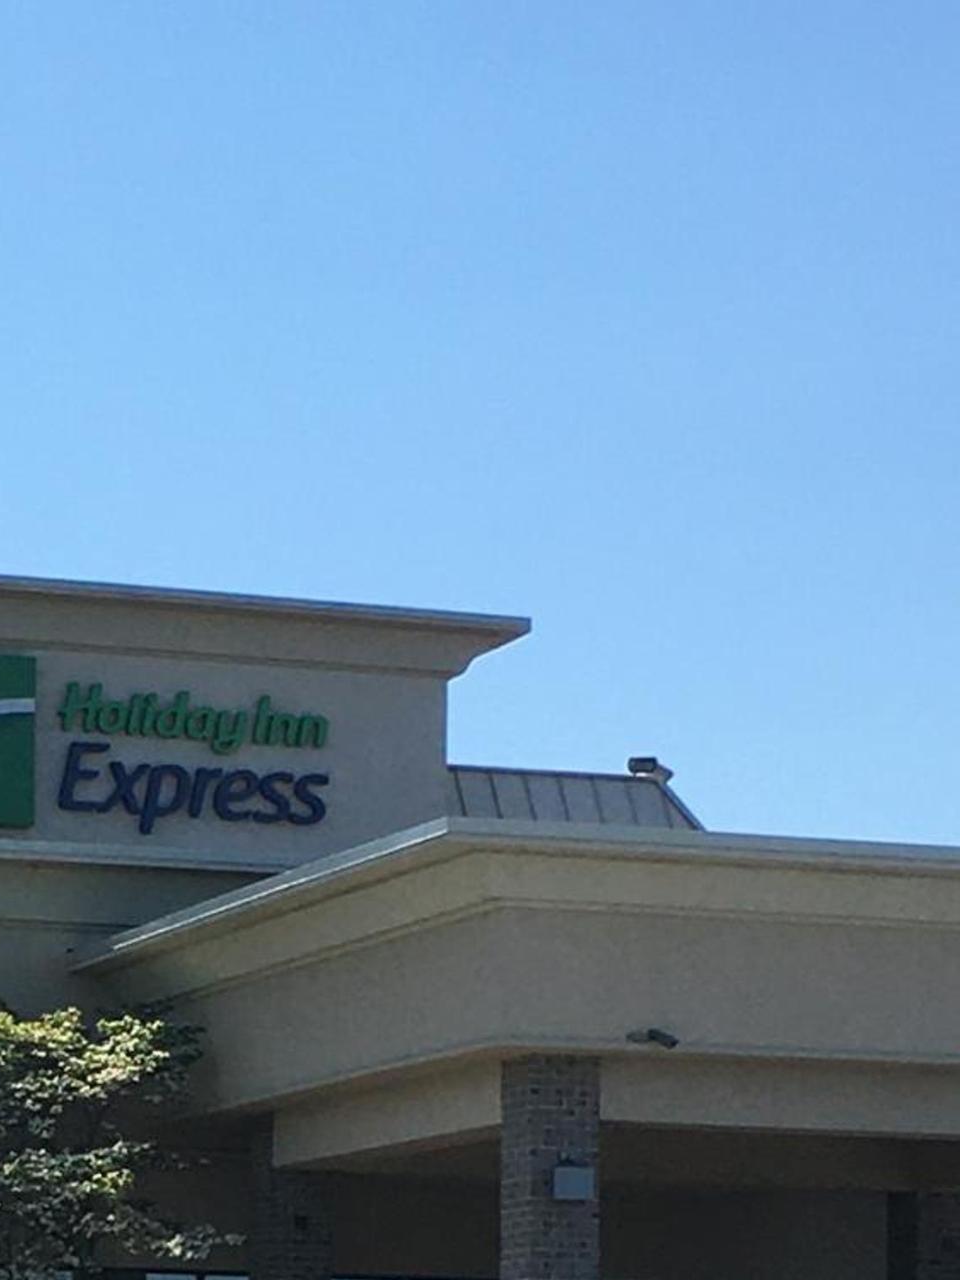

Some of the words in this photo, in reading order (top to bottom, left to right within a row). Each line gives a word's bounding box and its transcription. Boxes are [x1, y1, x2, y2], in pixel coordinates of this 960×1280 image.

[58, 682, 246, 755] Holiday
[252, 696, 329, 748] Inn
[58, 742, 329, 833] Express
